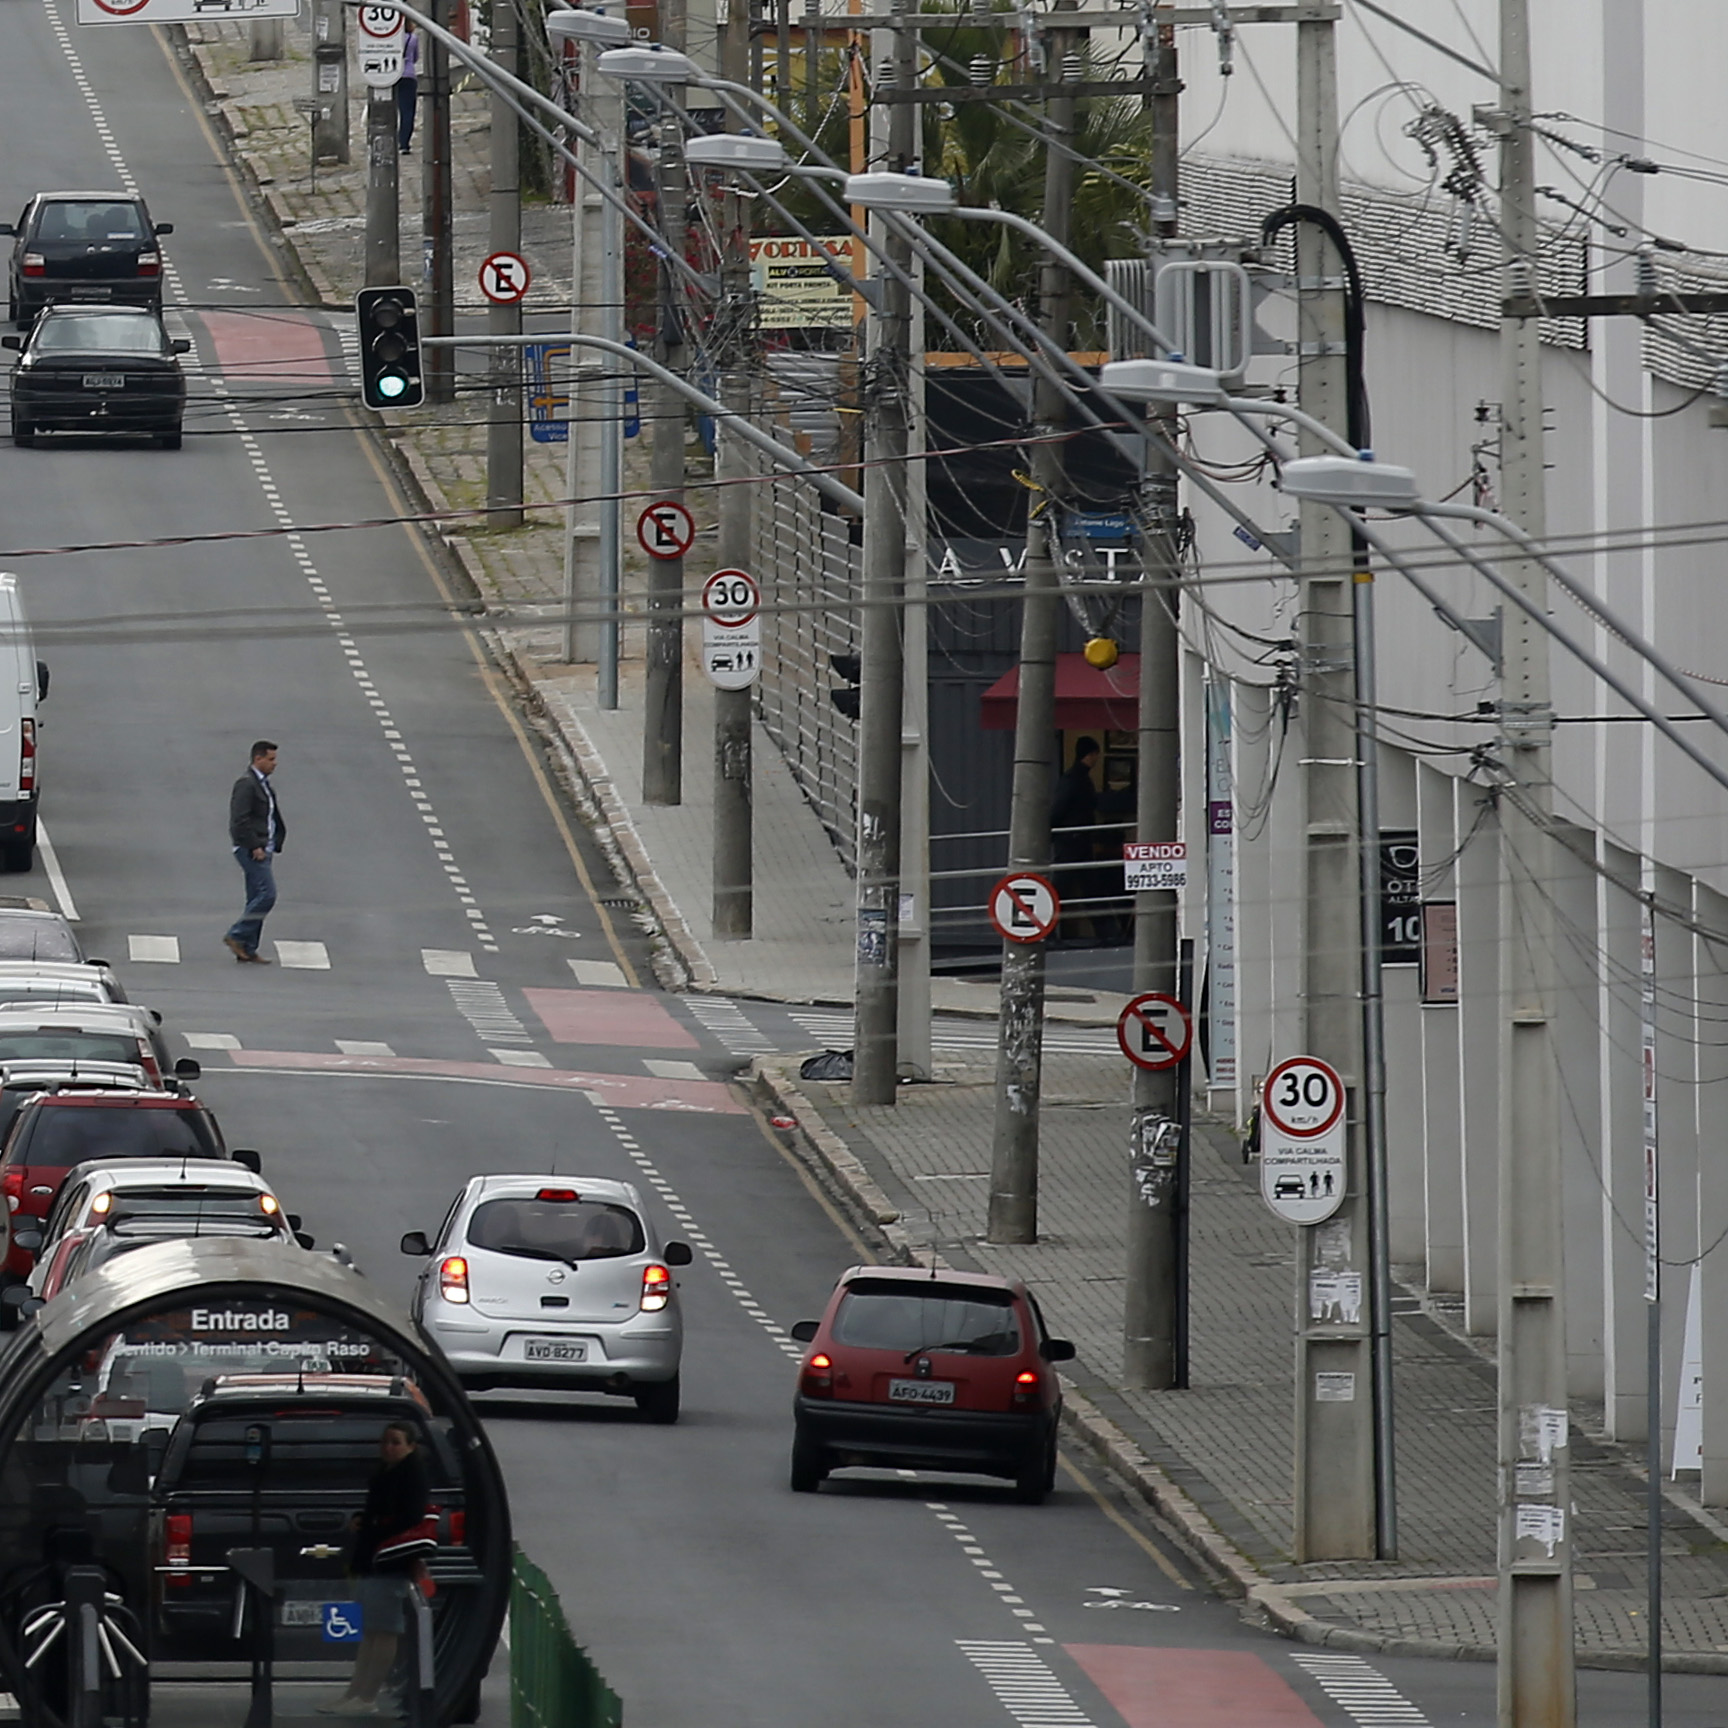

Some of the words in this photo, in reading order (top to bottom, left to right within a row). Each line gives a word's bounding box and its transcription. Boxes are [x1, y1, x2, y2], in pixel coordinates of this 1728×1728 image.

[368, 4, 395, 22] 30
[494, 264, 512, 293] E
[656, 513, 676, 547] E
[714, 581, 750, 606] 30
[1127, 845, 1185, 859] VENDO
[1139, 862, 1173, 873] APTO
[1011, 887, 1037, 928] E
[1142, 1009, 1168, 1053] E
[1279, 1072, 1328, 1108] 30
[1290, 1114, 1319, 1125] km/h
[1264, 1156, 1342, 1165] COMPARTILHADA
[1277, 1147, 1295, 1155] VIA
[1295, 1147, 1328, 1155] CALMA
[191, 1308, 290, 1331] Entrada
[191, 1341, 262, 1357] Terminal
[326, 1341, 371, 1357] Raso
